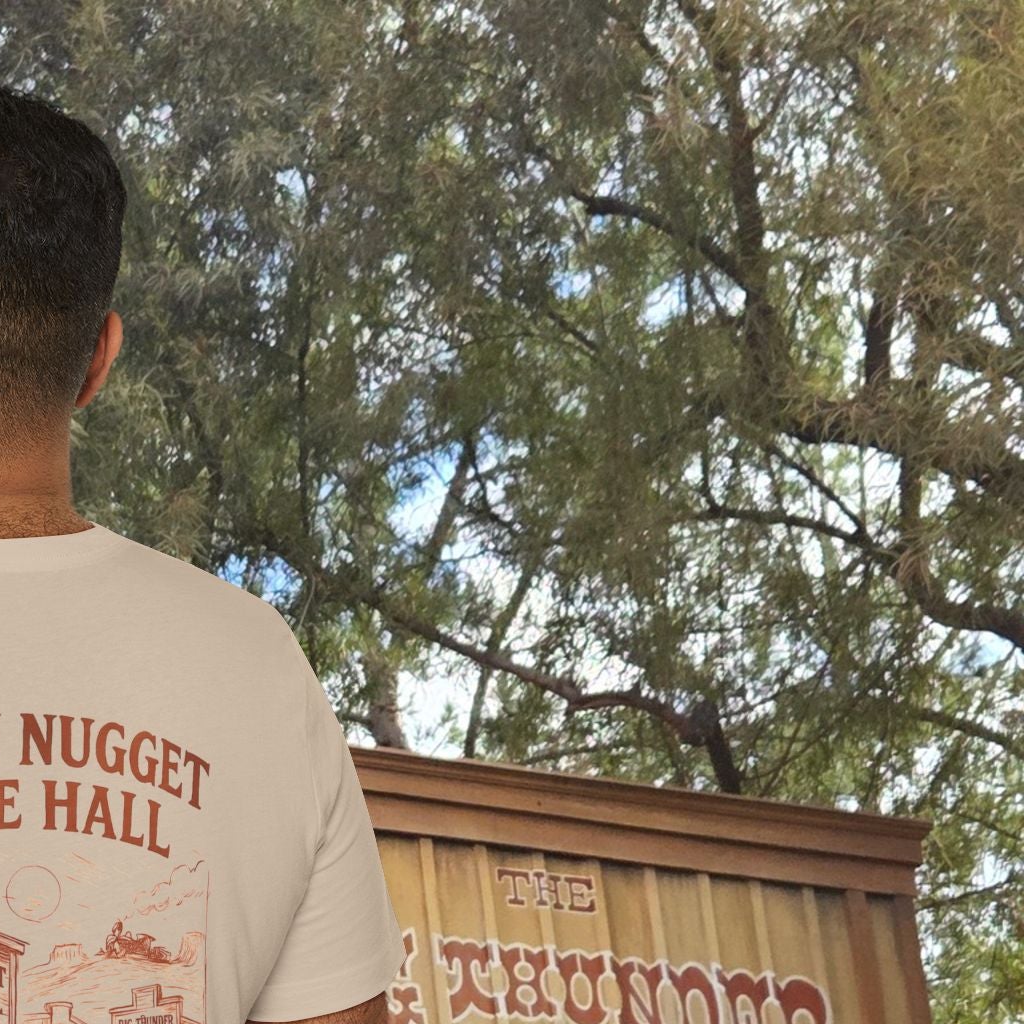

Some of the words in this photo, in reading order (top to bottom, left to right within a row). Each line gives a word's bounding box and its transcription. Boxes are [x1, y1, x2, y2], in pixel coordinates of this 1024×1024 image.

[19, 713, 211, 810] NUGGET
[42, 779, 171, 858] HALL
[496, 867, 598, 914] THE
